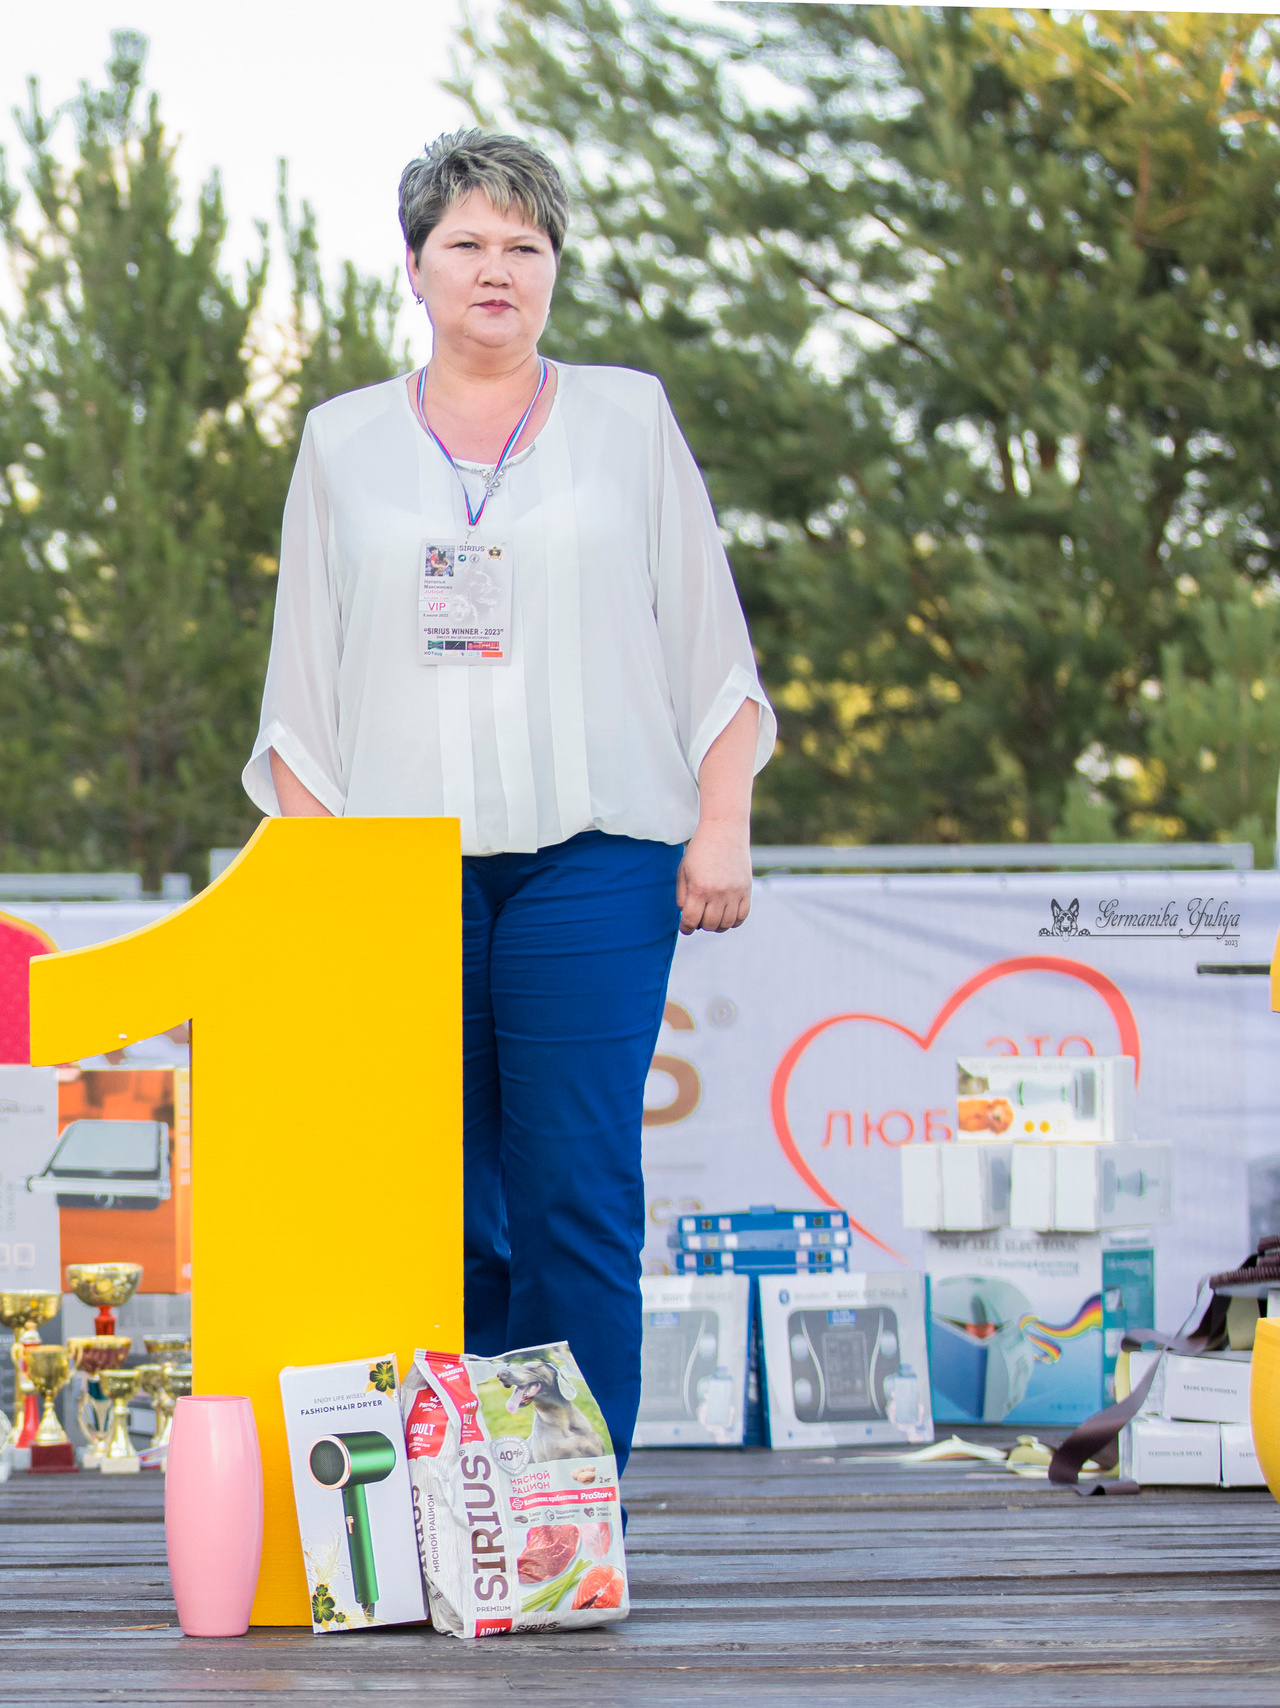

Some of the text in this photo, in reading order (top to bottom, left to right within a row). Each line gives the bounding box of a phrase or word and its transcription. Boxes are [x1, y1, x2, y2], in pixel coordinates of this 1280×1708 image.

[428, 602, 446, 611] VIP
[452, 628, 478, 636] WINNER
[30, 817, 463, 1629] 1
[438, 1367, 464, 1378] PREMIUM
[446, 1374, 460, 1382] FOOD
[314, 1396, 332, 1404] ENJOY
[346, 1392, 366, 1400] WISELY
[300, 1400, 382, 1416] FASHION HAIR DRYER
[410, 1423, 436, 1436] ADULT
[500, 1448, 522, 1461] 40%
[510, 1470, 550, 1486] МЯСНОЙ
[512, 1482, 550, 1494] РАЦИОН
[580, 1492, 613, 1500] ProStor+
[428, 1494, 440, 1573] МЯСНОЙ РАЦИОН
[461, 1455, 508, 1601] SIRIUS
